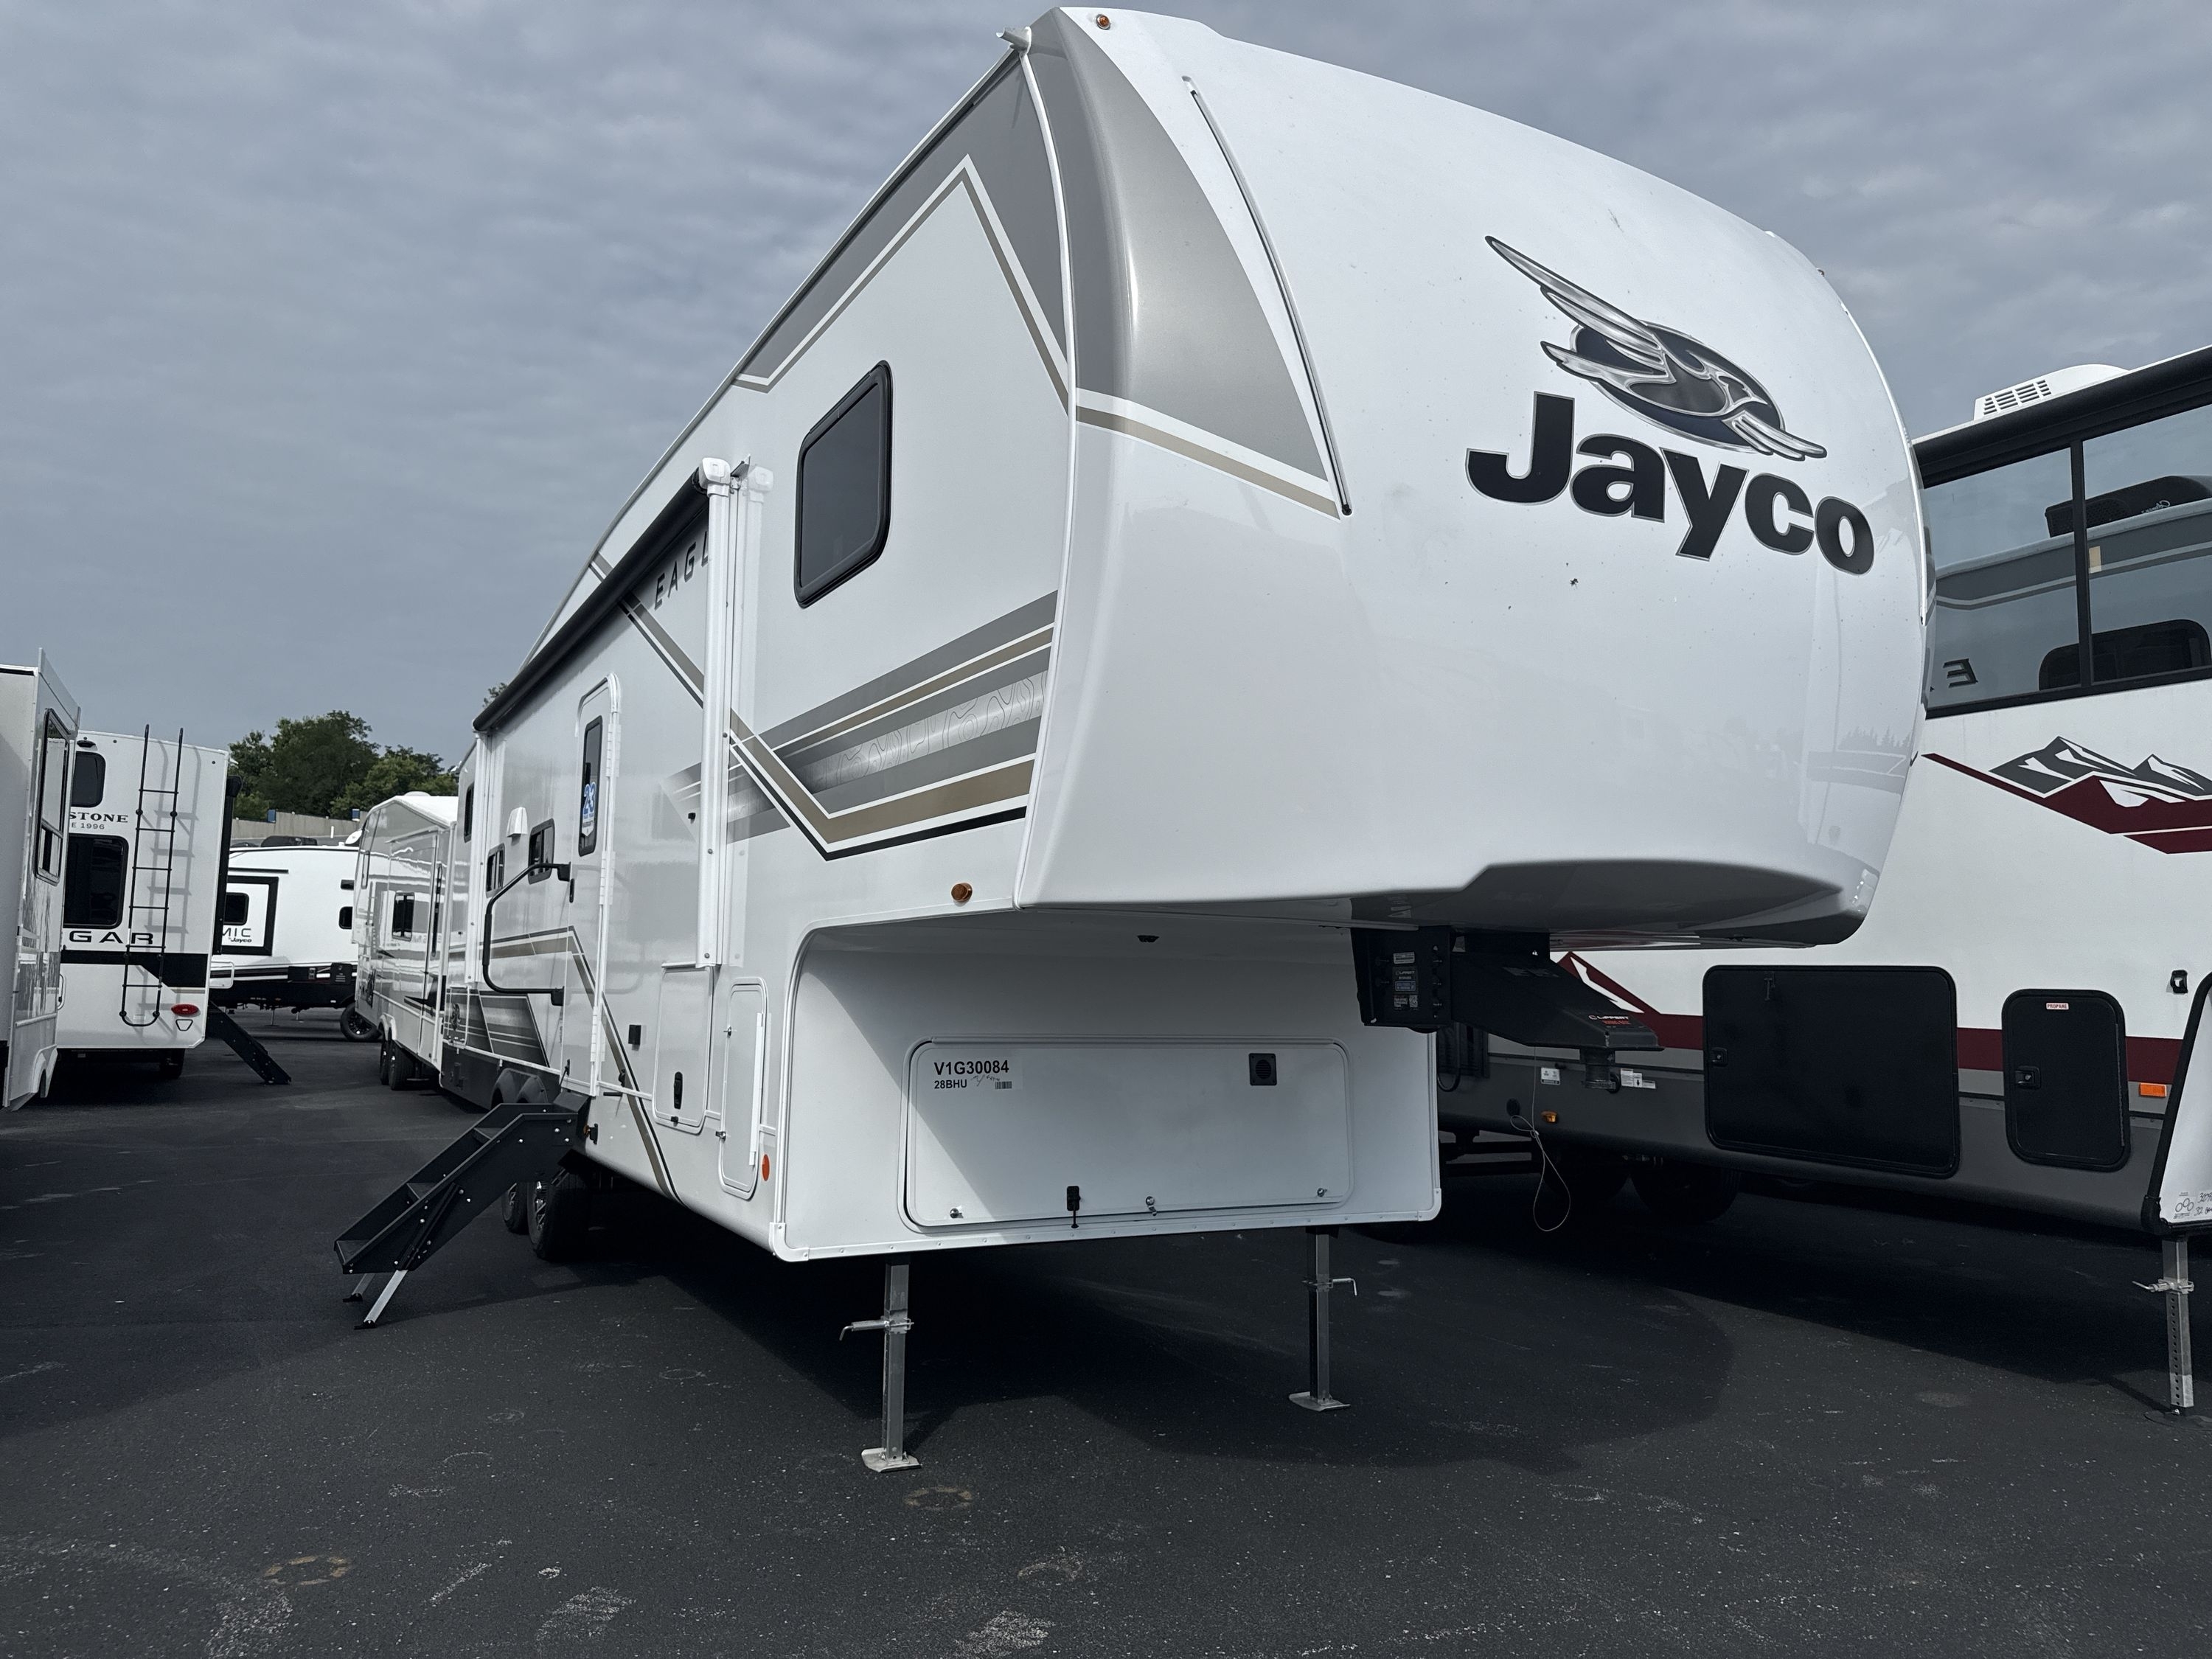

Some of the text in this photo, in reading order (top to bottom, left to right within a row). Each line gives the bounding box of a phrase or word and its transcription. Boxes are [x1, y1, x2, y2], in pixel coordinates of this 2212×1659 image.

[1465, 390, 1875, 576] Jayco
[933, 1060, 1009, 1076] V1G30084
[933, 1079, 967, 1089] 28BHU
